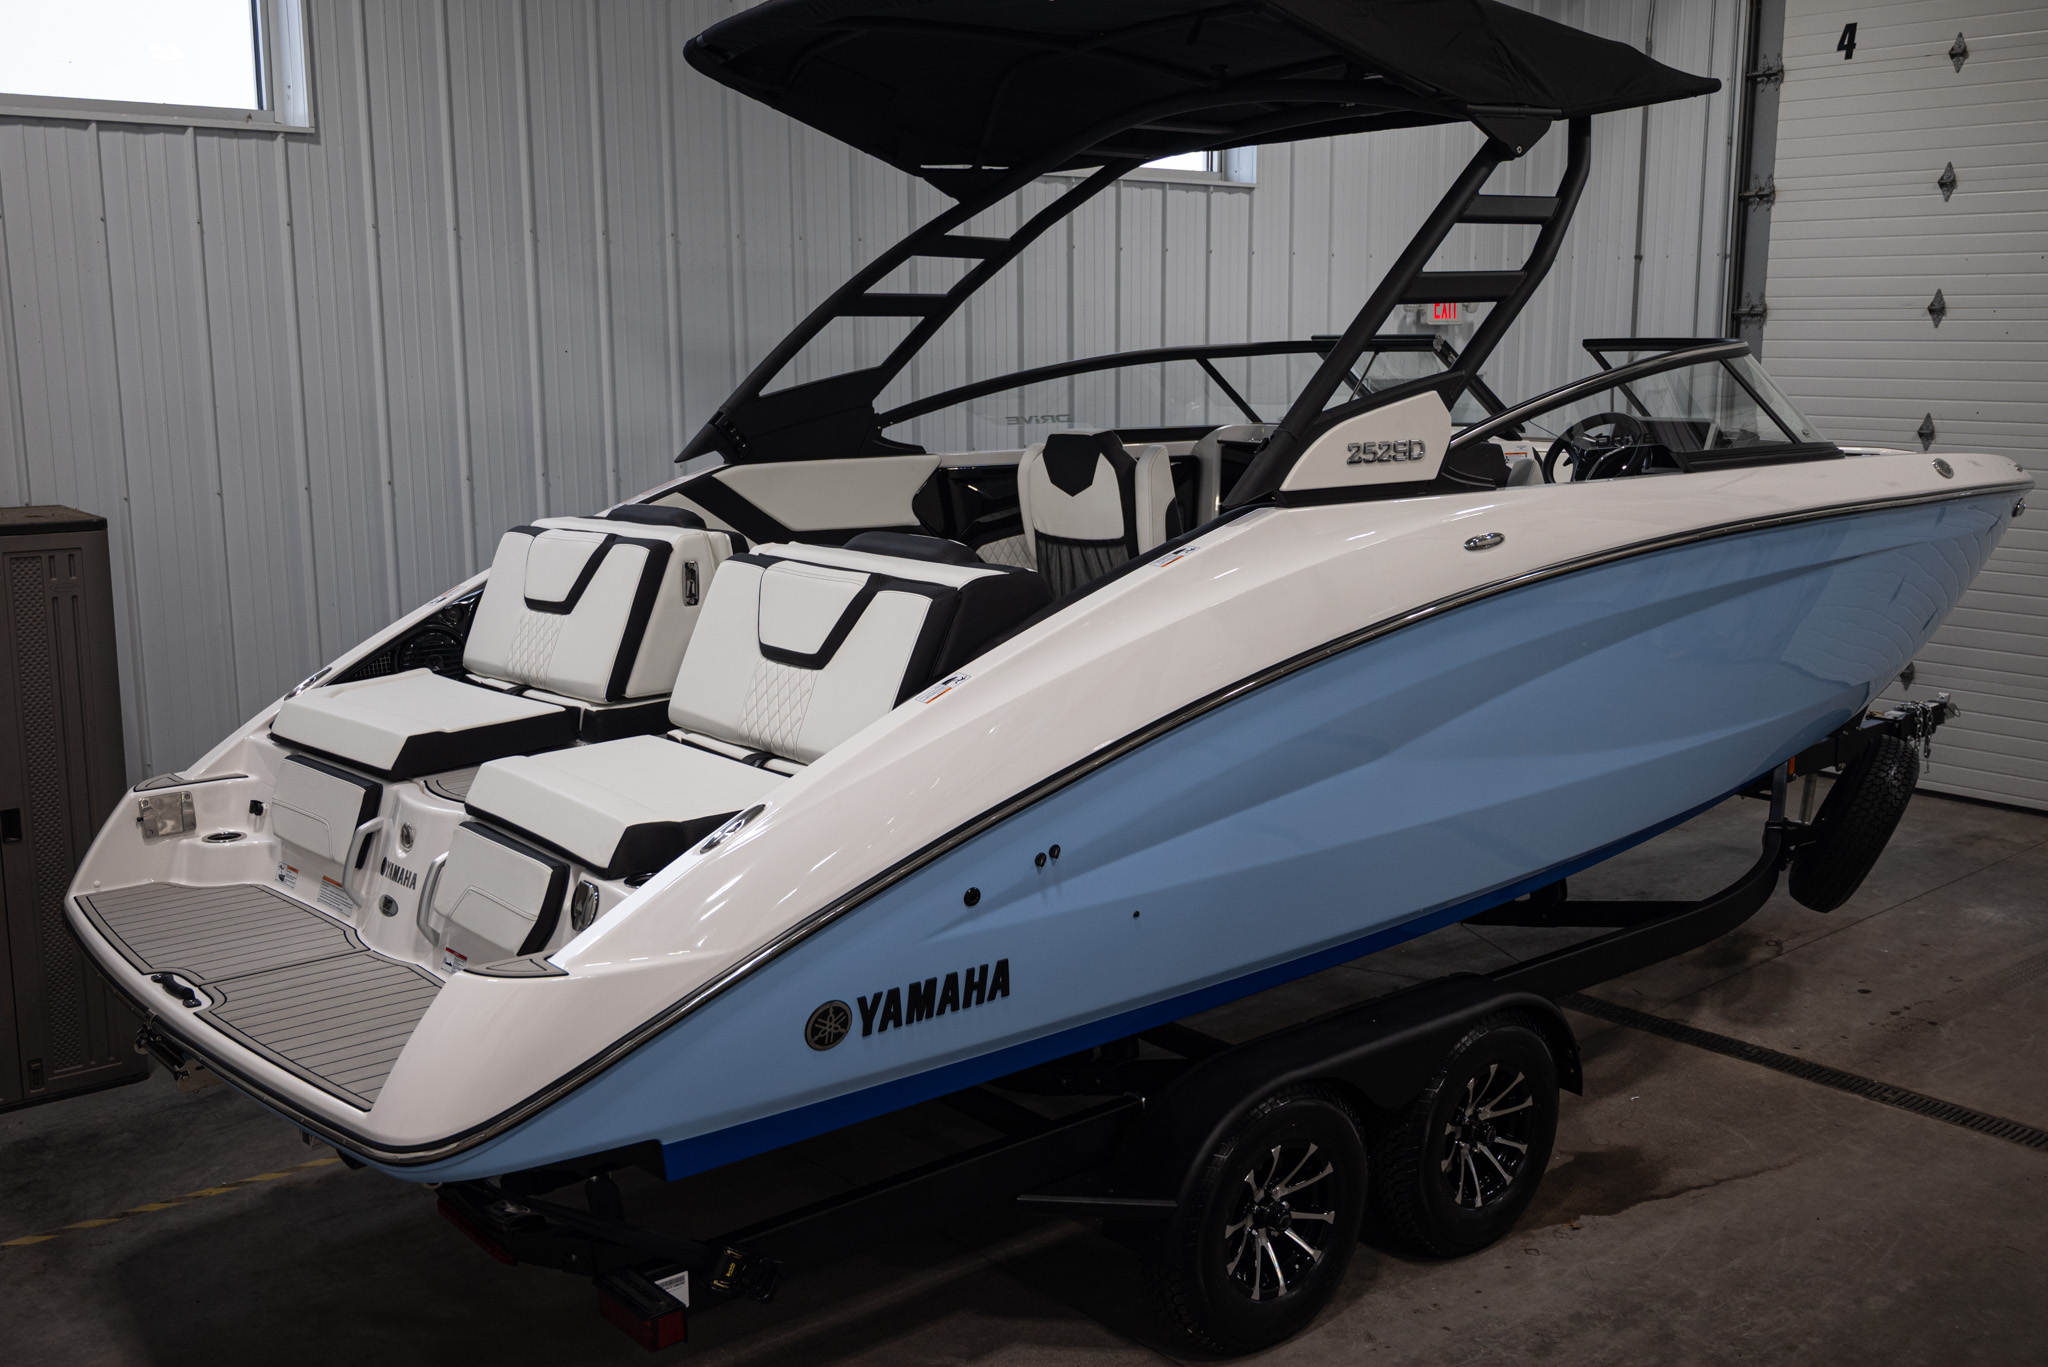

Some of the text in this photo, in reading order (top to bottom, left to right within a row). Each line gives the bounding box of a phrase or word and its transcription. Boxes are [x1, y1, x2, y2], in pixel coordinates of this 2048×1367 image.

[1837, 22, 1857, 60] 4
[1347, 440, 1425, 464] 252SD
[385, 860, 417, 890] YAMAHA
[857, 958, 1010, 1037] YAMAHA
